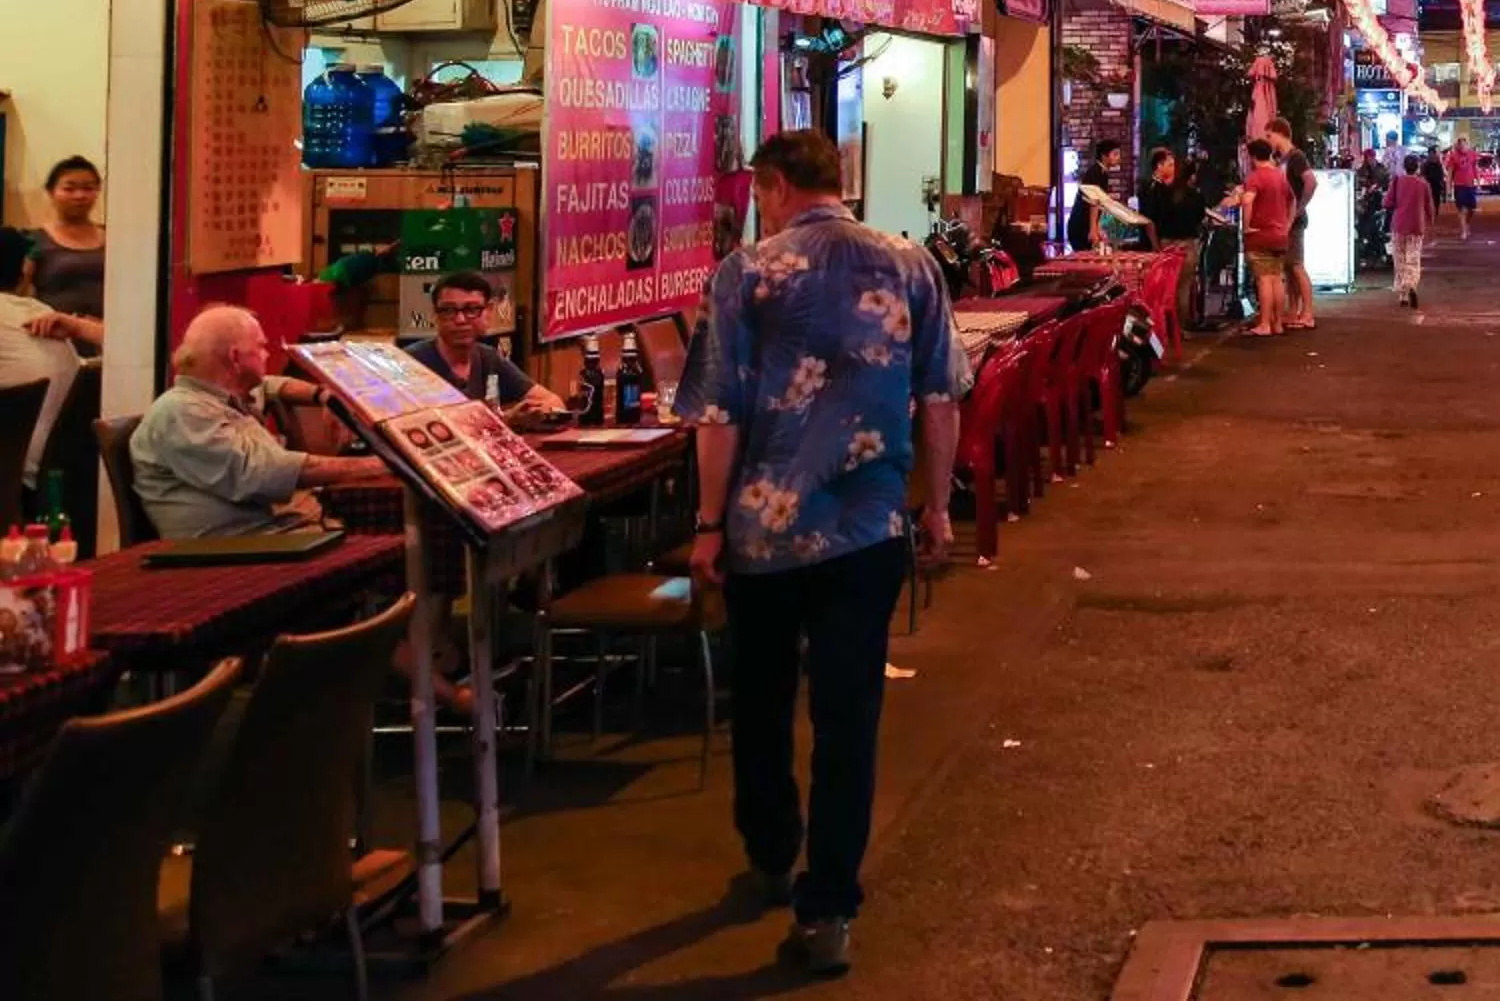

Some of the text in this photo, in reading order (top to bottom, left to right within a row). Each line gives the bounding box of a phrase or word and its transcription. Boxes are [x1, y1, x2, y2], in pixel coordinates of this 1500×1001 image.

[561, 24, 627, 60] TACOS
[560, 78, 659, 111] QUESADILLAS
[558, 131, 632, 161] BURRITOS
[557, 180, 630, 214] FAJITAS
[556, 231, 626, 267] NACHOS
[555, 275, 653, 320] ENCHALADAS
